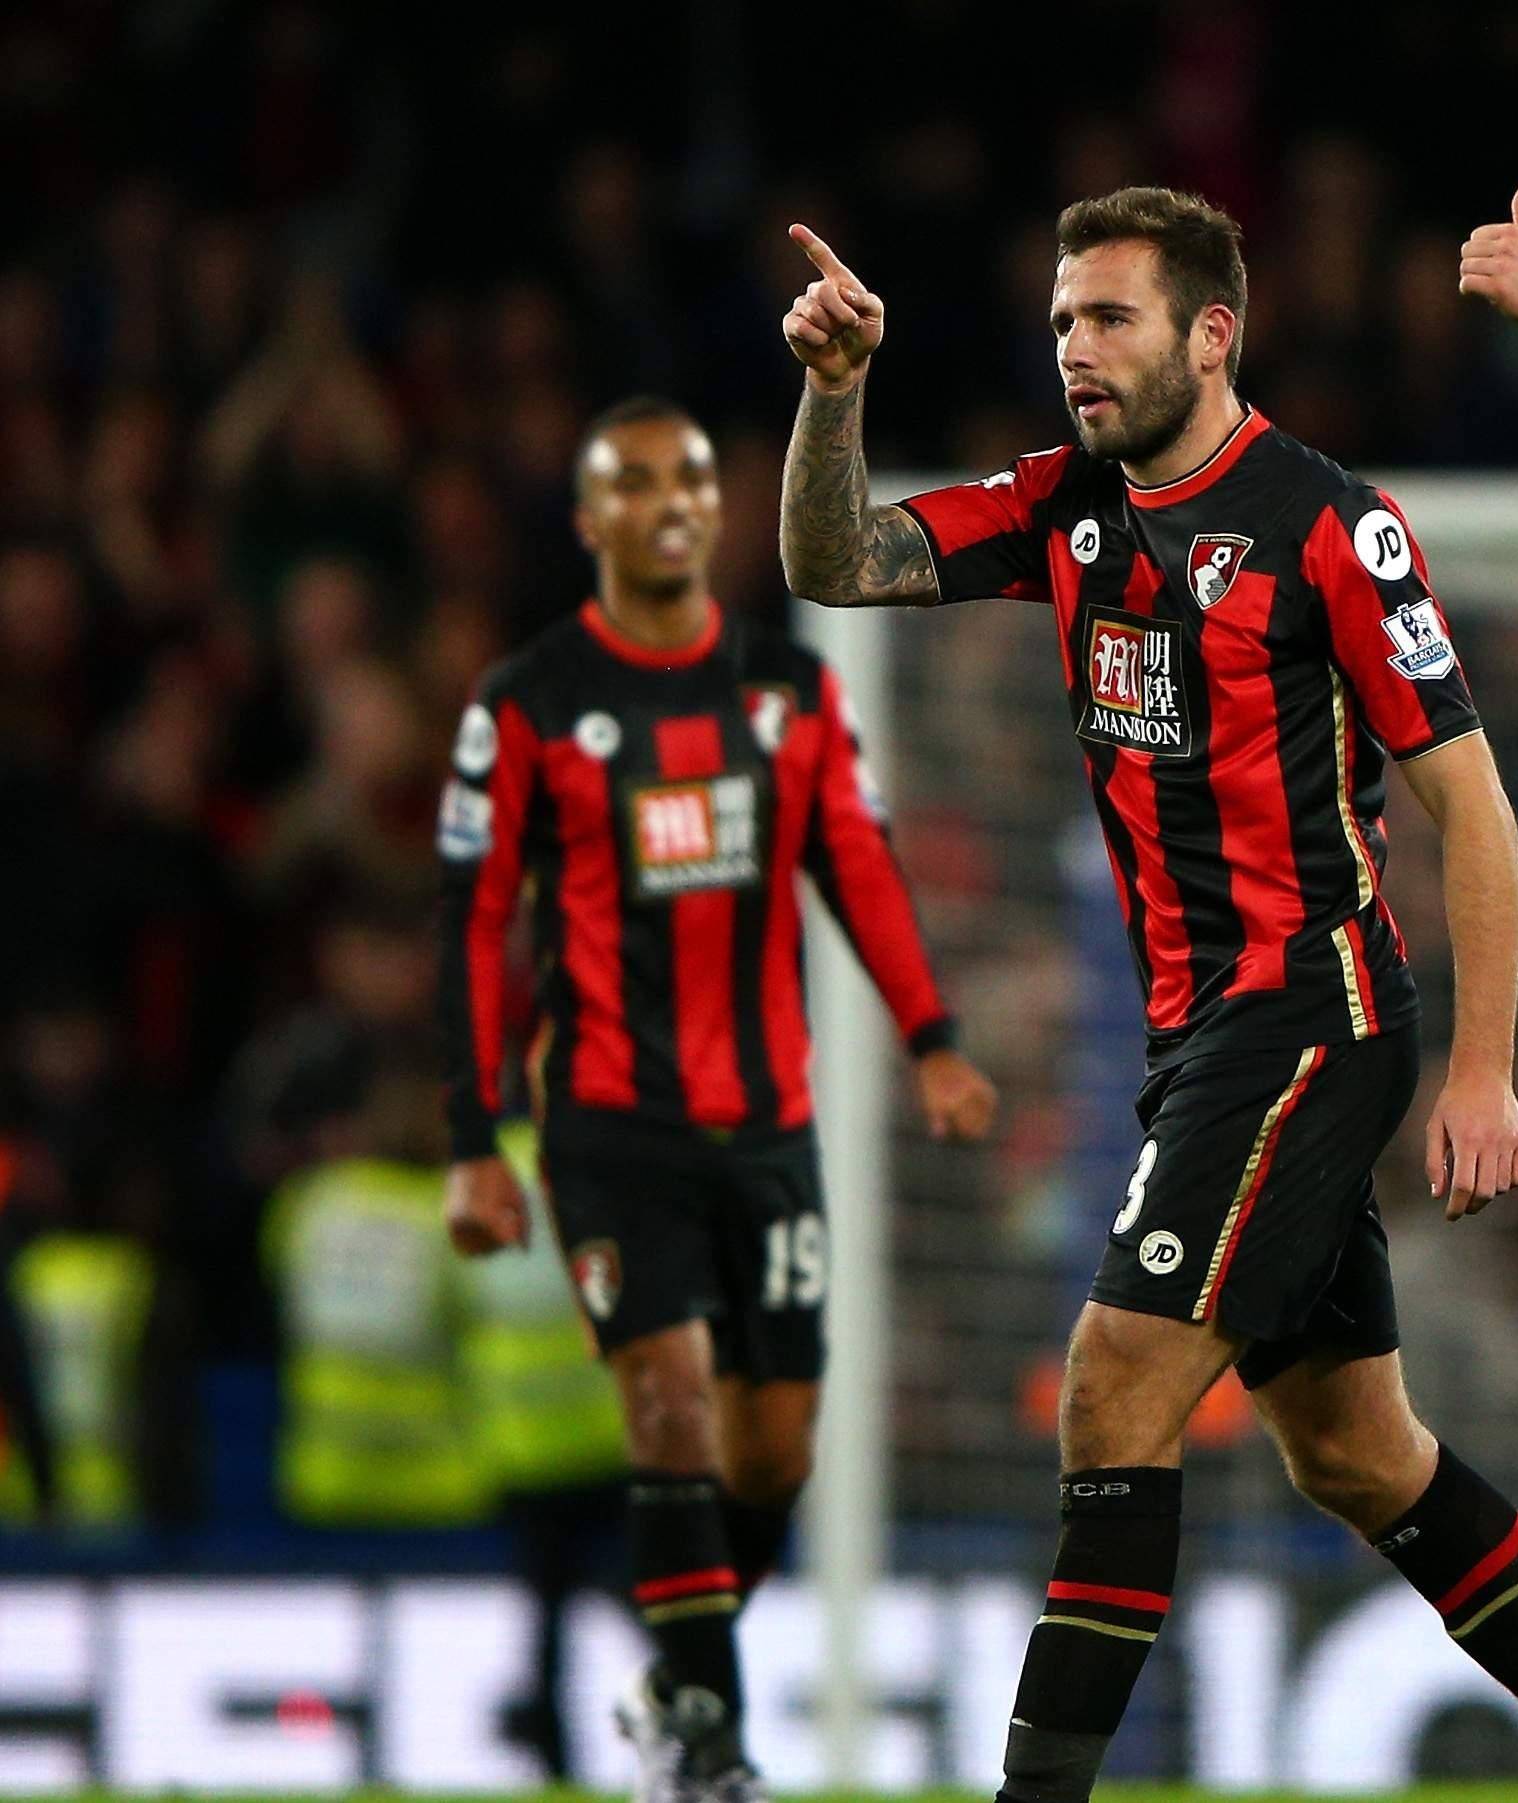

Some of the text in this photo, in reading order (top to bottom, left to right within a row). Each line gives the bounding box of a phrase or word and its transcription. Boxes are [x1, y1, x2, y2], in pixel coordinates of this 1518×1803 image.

[1074, 531, 1096, 552] JD
[1374, 524, 1402, 569] JD
[1090, 707, 1182, 746] MANSION
[1147, 1243, 1177, 1264] JD
